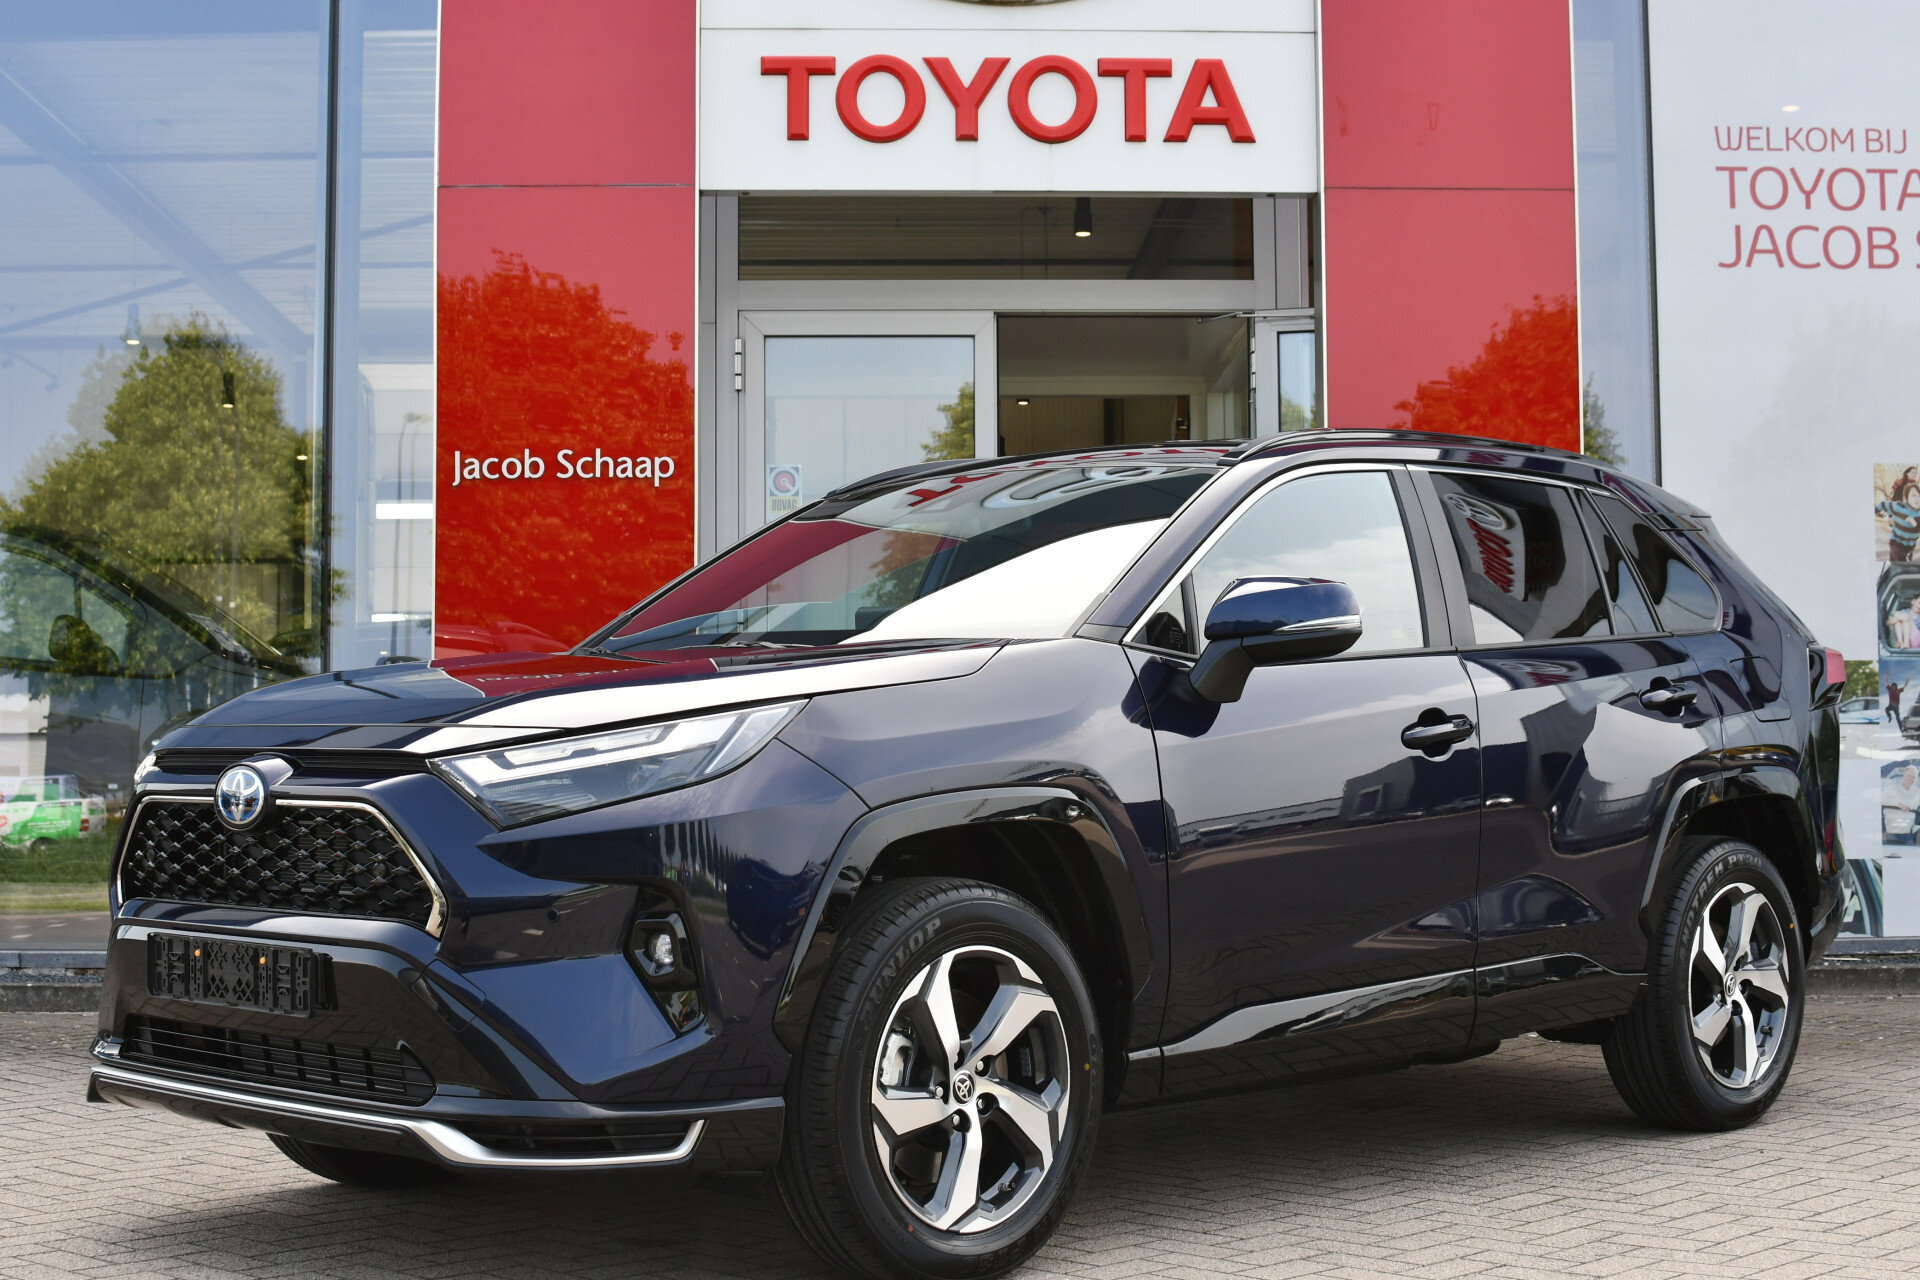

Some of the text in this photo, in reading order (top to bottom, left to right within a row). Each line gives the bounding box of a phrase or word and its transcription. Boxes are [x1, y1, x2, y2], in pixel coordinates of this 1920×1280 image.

[760, 54, 1256, 144] TOYOTA
[1714, 125, 1907, 154] WELKOM BIJ
[1715, 166, 1920, 211] TOYOTA
[1718, 224, 1899, 269] JACOB
[452, 448, 675, 487] Jacob Schaap
[771, 499, 797, 511] BOVAG
[860, 917, 941, 1021] DUNLOP
